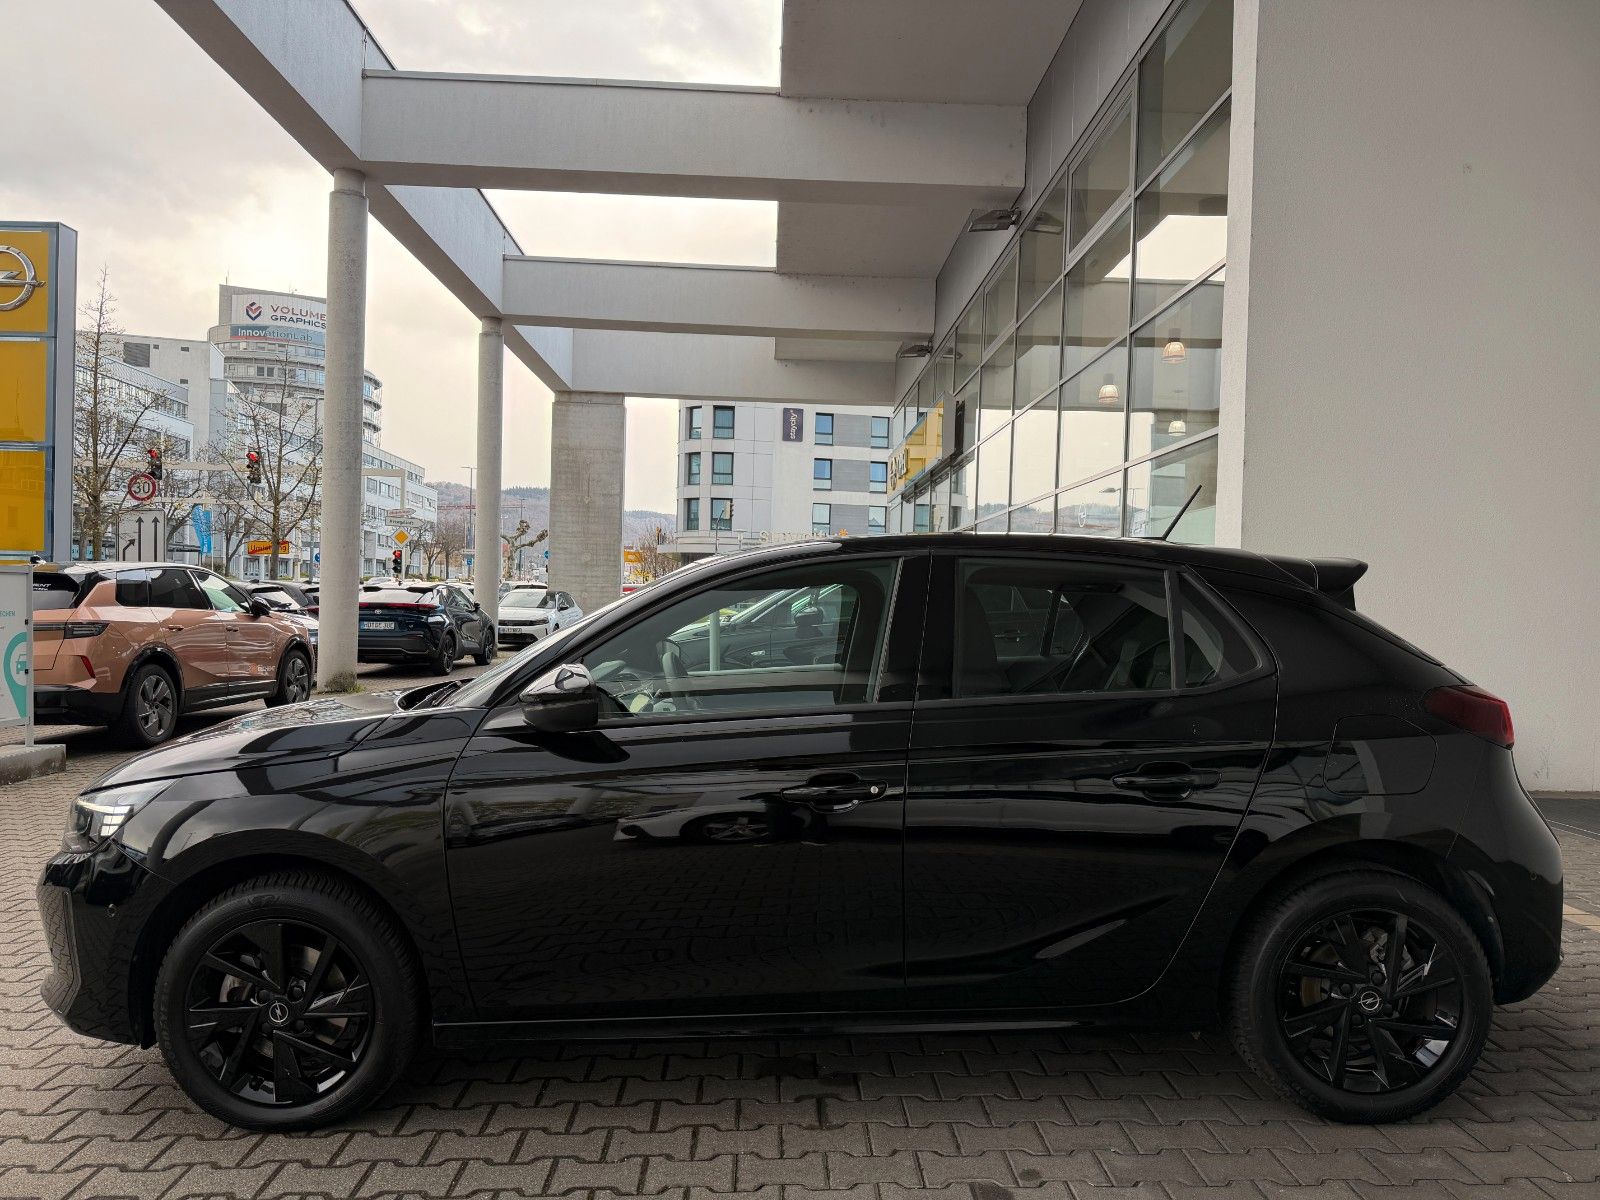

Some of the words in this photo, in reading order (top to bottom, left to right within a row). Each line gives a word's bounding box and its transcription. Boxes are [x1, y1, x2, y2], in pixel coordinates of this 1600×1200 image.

[270, 304, 327, 321] VOLUME
[270, 314, 327, 329] GRAPHICS
[132, 482, 150, 493] 30
